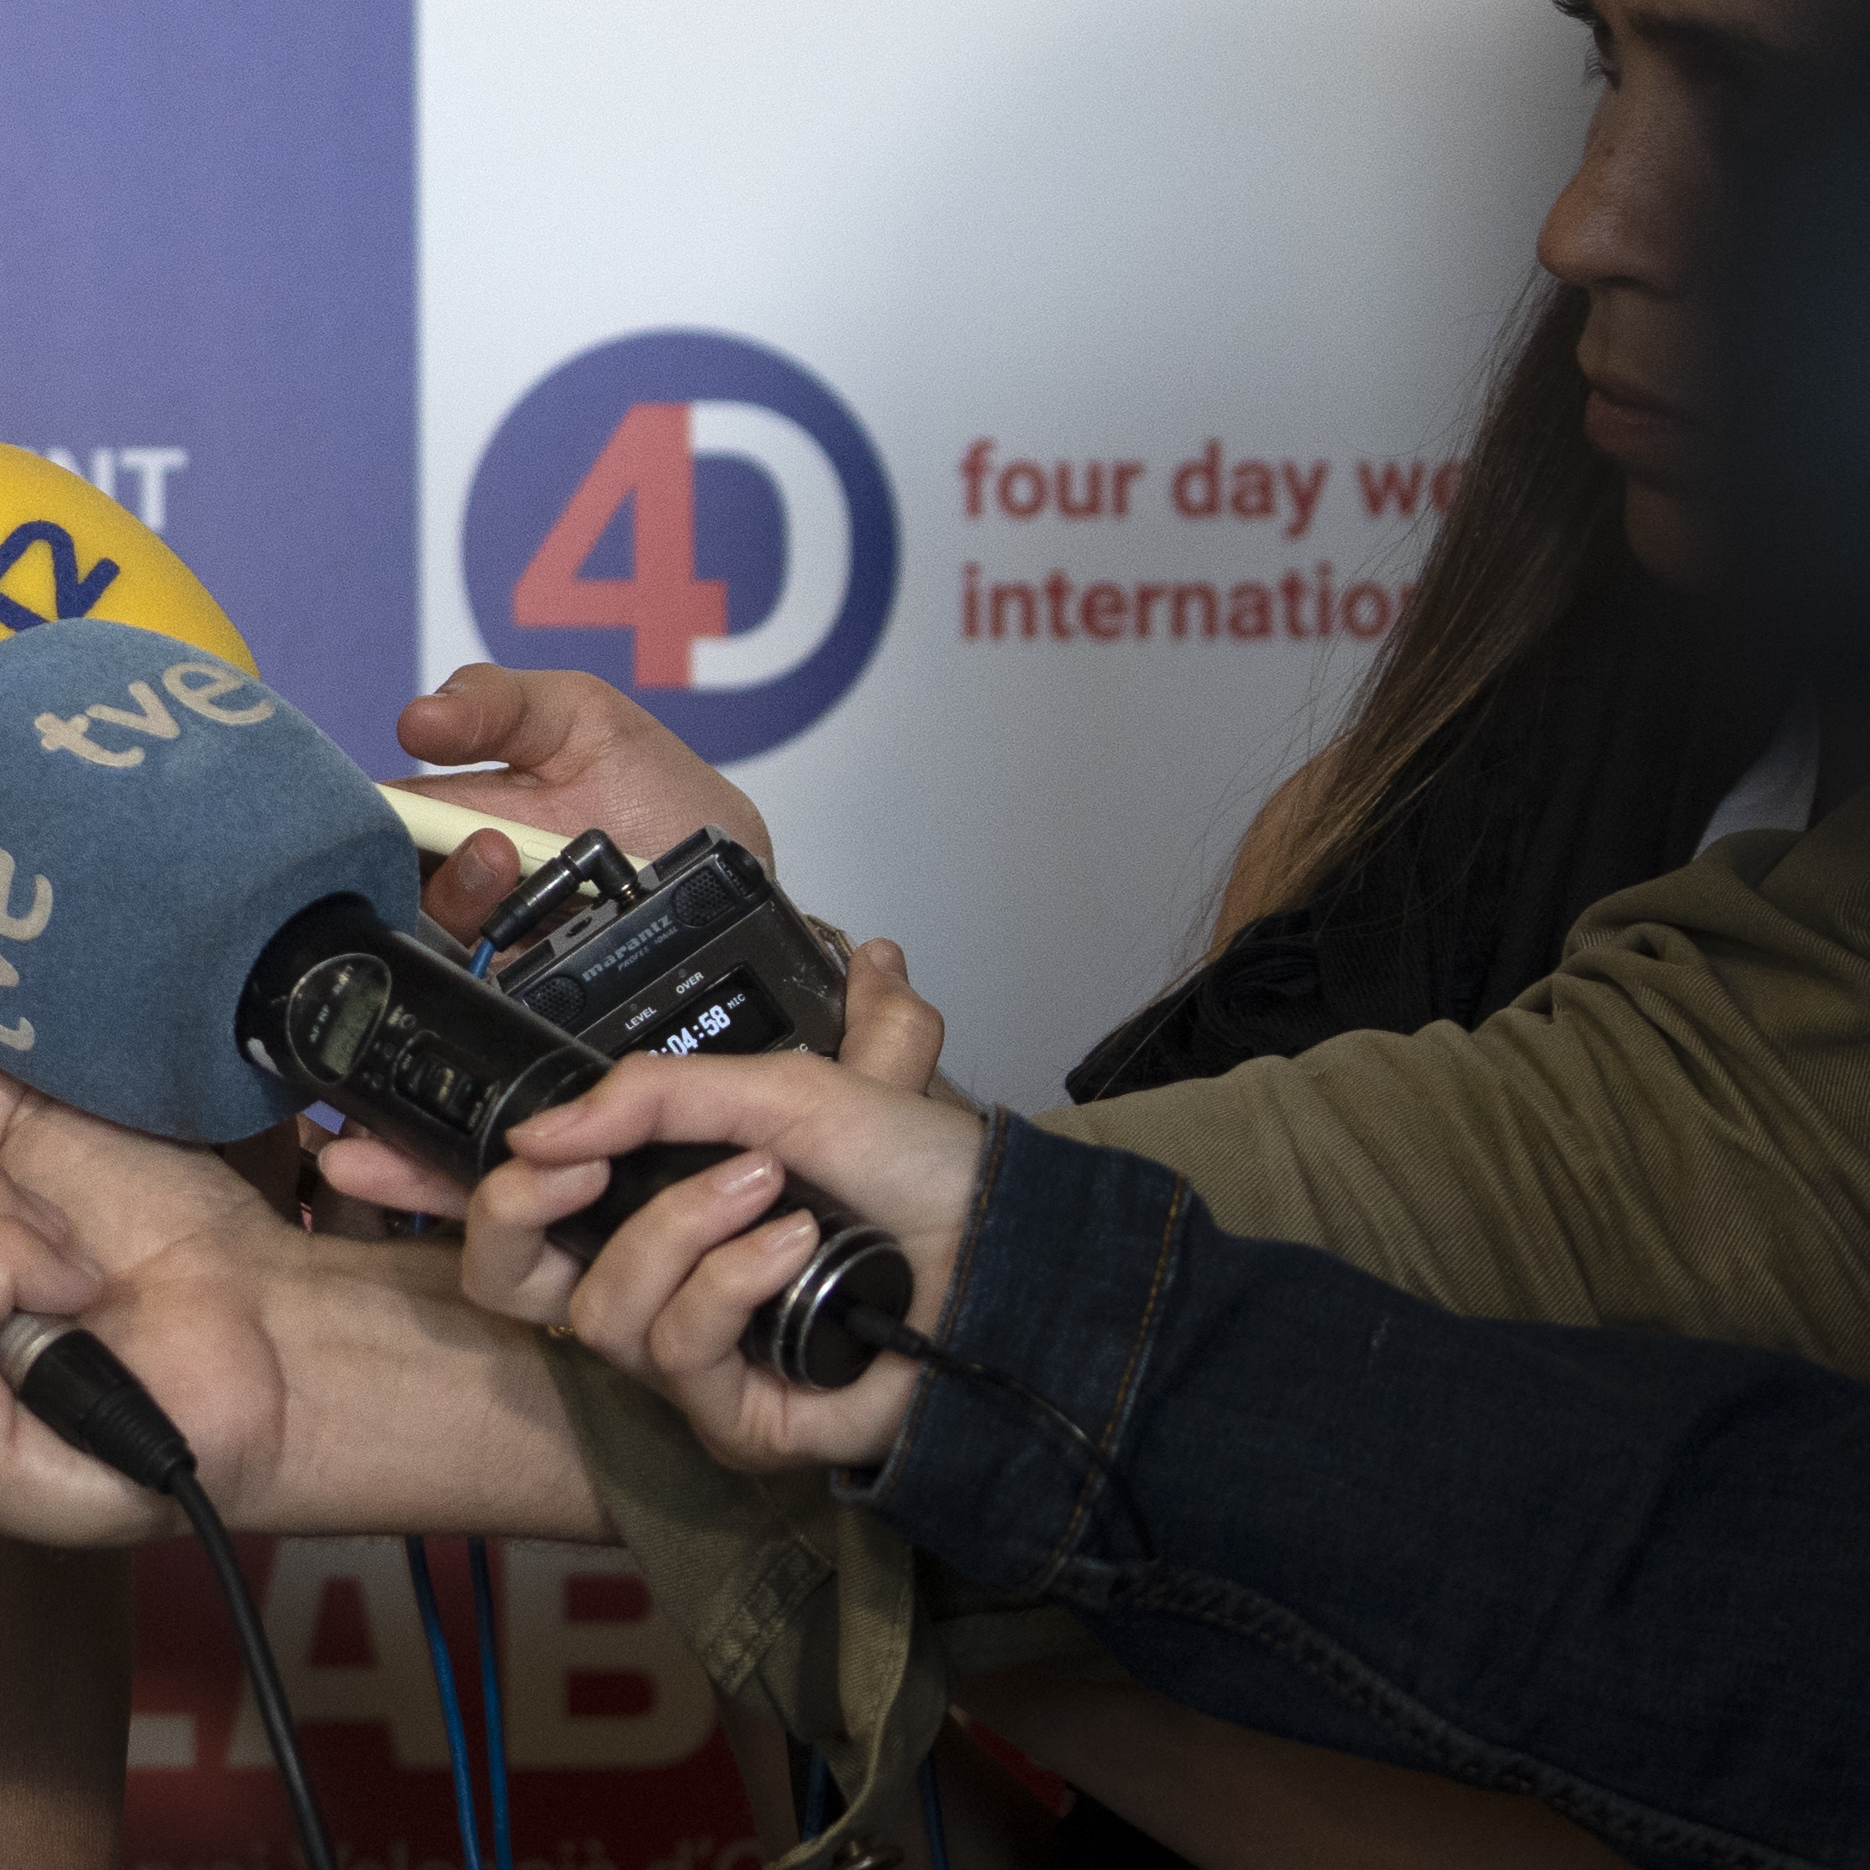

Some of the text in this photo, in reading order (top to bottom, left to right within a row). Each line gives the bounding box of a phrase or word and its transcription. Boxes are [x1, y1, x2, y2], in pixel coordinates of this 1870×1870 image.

[957, 436, 1145, 522] four
[1169, 436, 1330, 541] day
[512, 399, 853, 692] 4D
[961, 560, 1417, 642] internatio
[33, 659, 277, 769] tve
[581, 914, 673, 983] marantz
[617, 926, 679, 972] PROFESIONAL
[675, 971, 705, 995] OVER
[624, 1006, 658, 1031] LEVEL
[648, 1004, 731, 1056] :04:58
[726, 992, 747, 1010] MIC
[128, 1535, 720, 1770] AB
